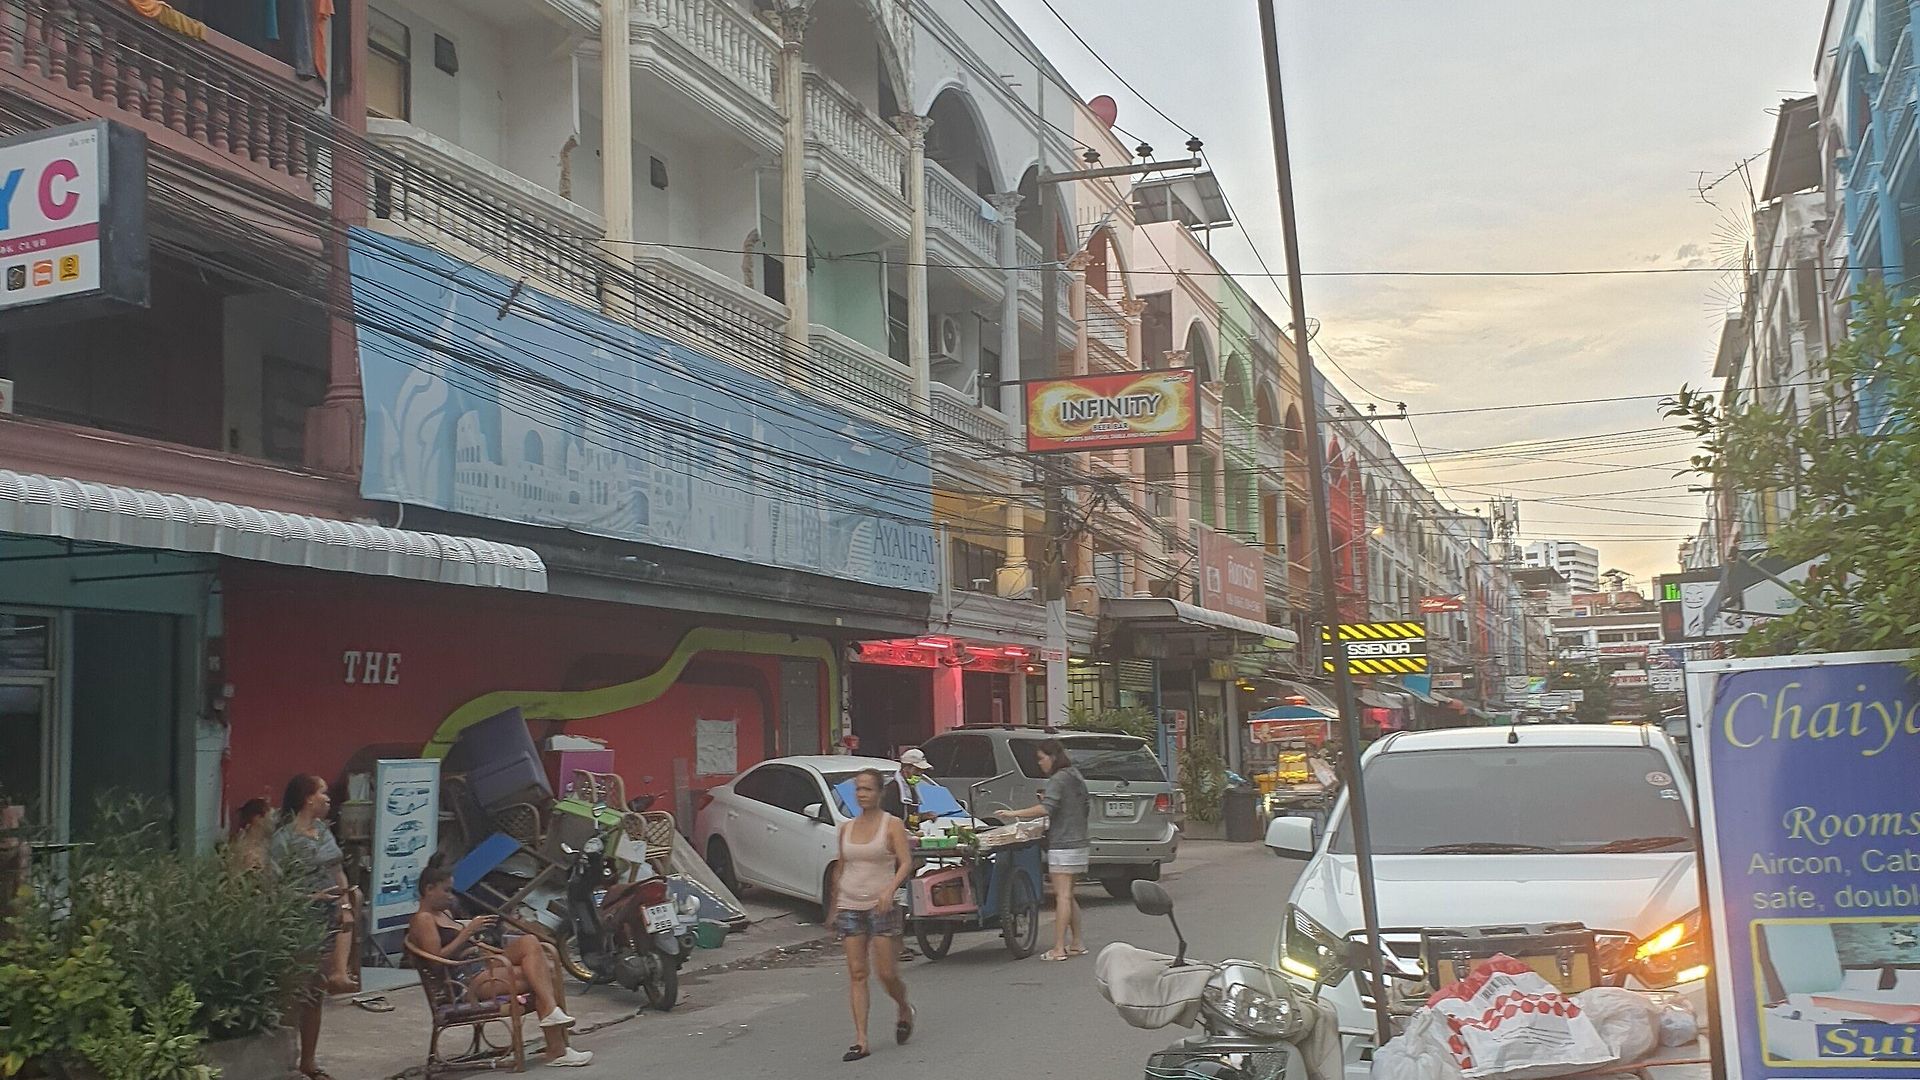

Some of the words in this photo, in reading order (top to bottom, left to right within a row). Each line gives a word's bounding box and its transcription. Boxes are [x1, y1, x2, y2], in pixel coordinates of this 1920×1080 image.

[1061, 393, 1161, 421] INFINITY
[1092, 423, 1112, 432] BEER
[1114, 422, 1130, 431] BAR
[1346, 643, 1411, 655] SSIENDA
[343, 650, 401, 685] THE
[1748, 850, 1852, 877] Aircon,
[1753, 885, 1825, 912] safe,
[1834, 883, 1920, 909] doubl
[1822, 1026, 1919, 1056] Sui
